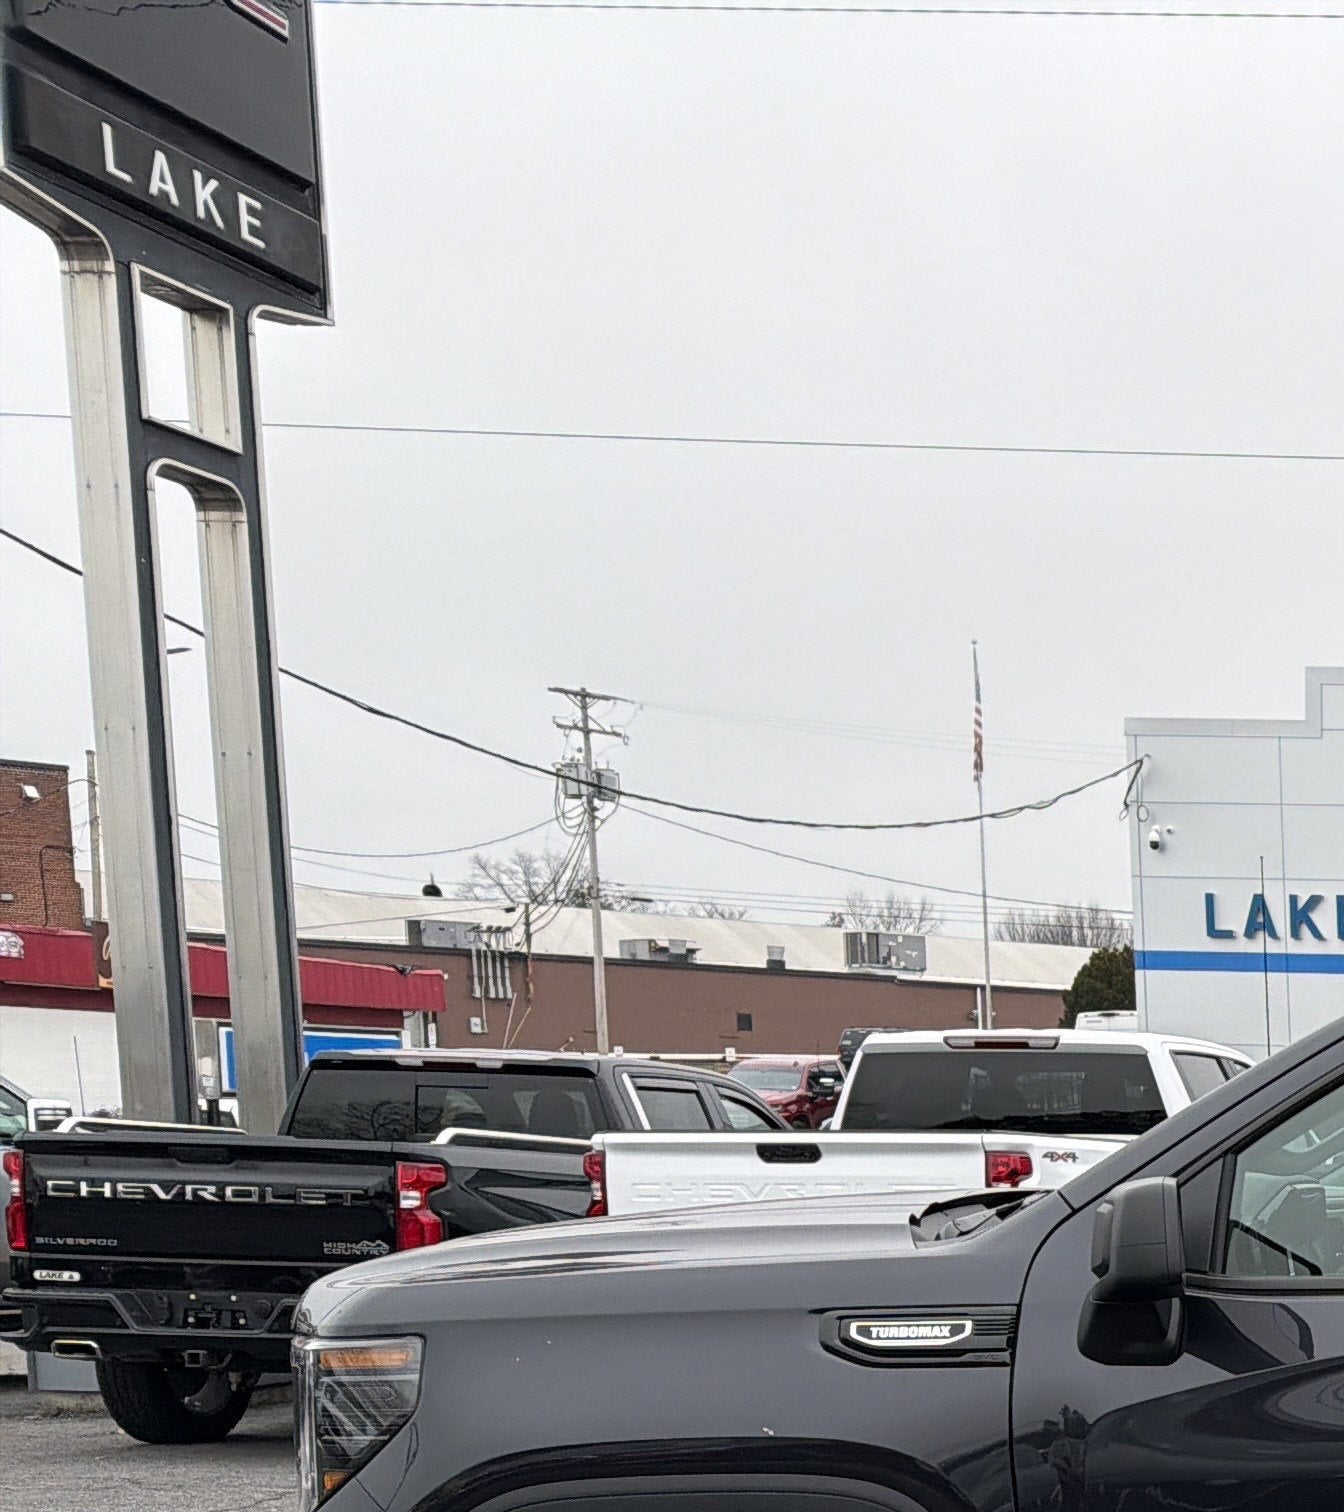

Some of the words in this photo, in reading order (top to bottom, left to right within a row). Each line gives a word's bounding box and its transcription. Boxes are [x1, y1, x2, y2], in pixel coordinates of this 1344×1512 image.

[101, 121, 266, 250] LAKE
[46, 1180, 366, 1206] CHEVROLET
[34, 1235, 118, 1247] SILVERADO
[38, 1271, 65, 1280] LAKE
[869, 1325, 952, 1339] TURBOMAX
